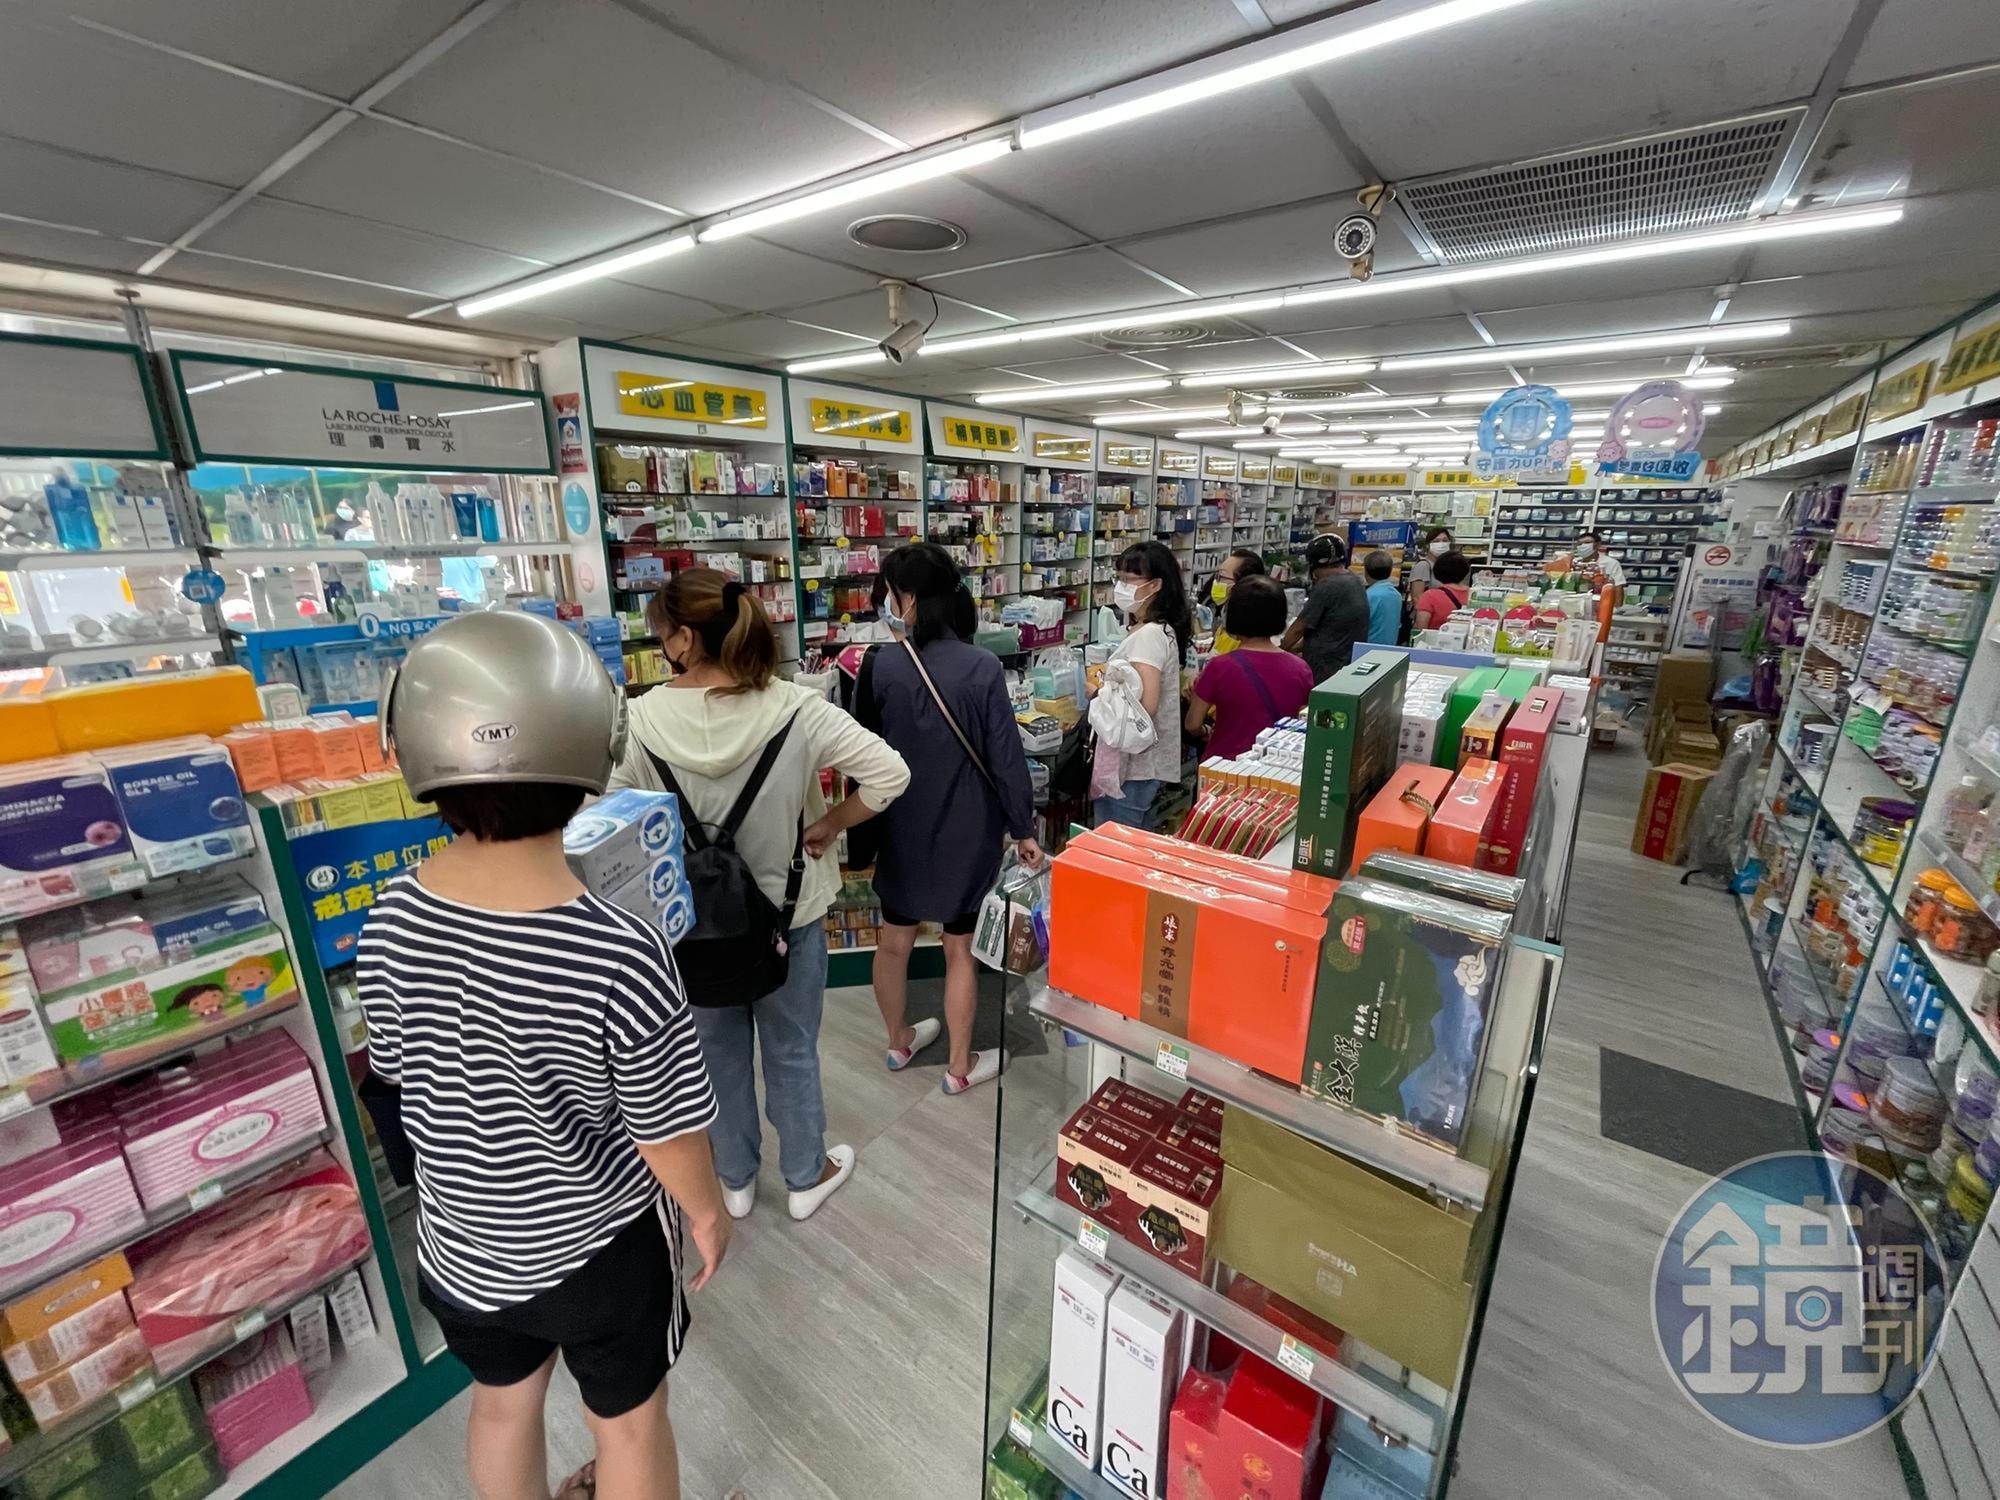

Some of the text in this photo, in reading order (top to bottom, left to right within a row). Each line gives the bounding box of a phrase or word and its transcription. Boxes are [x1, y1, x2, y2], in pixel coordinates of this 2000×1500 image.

[322, 408, 451, 429] LA ROCHE-POSAY
[326, 422, 381, 434] LABORATOIRE
[476, 725, 512, 741] YMT
[123, 770, 197, 790] BORAGE OIL
[344, 834, 457, 880] 本單位開
[1052, 1399, 1088, 1455] Ca
[1107, 1442, 1149, 1498] Ca
